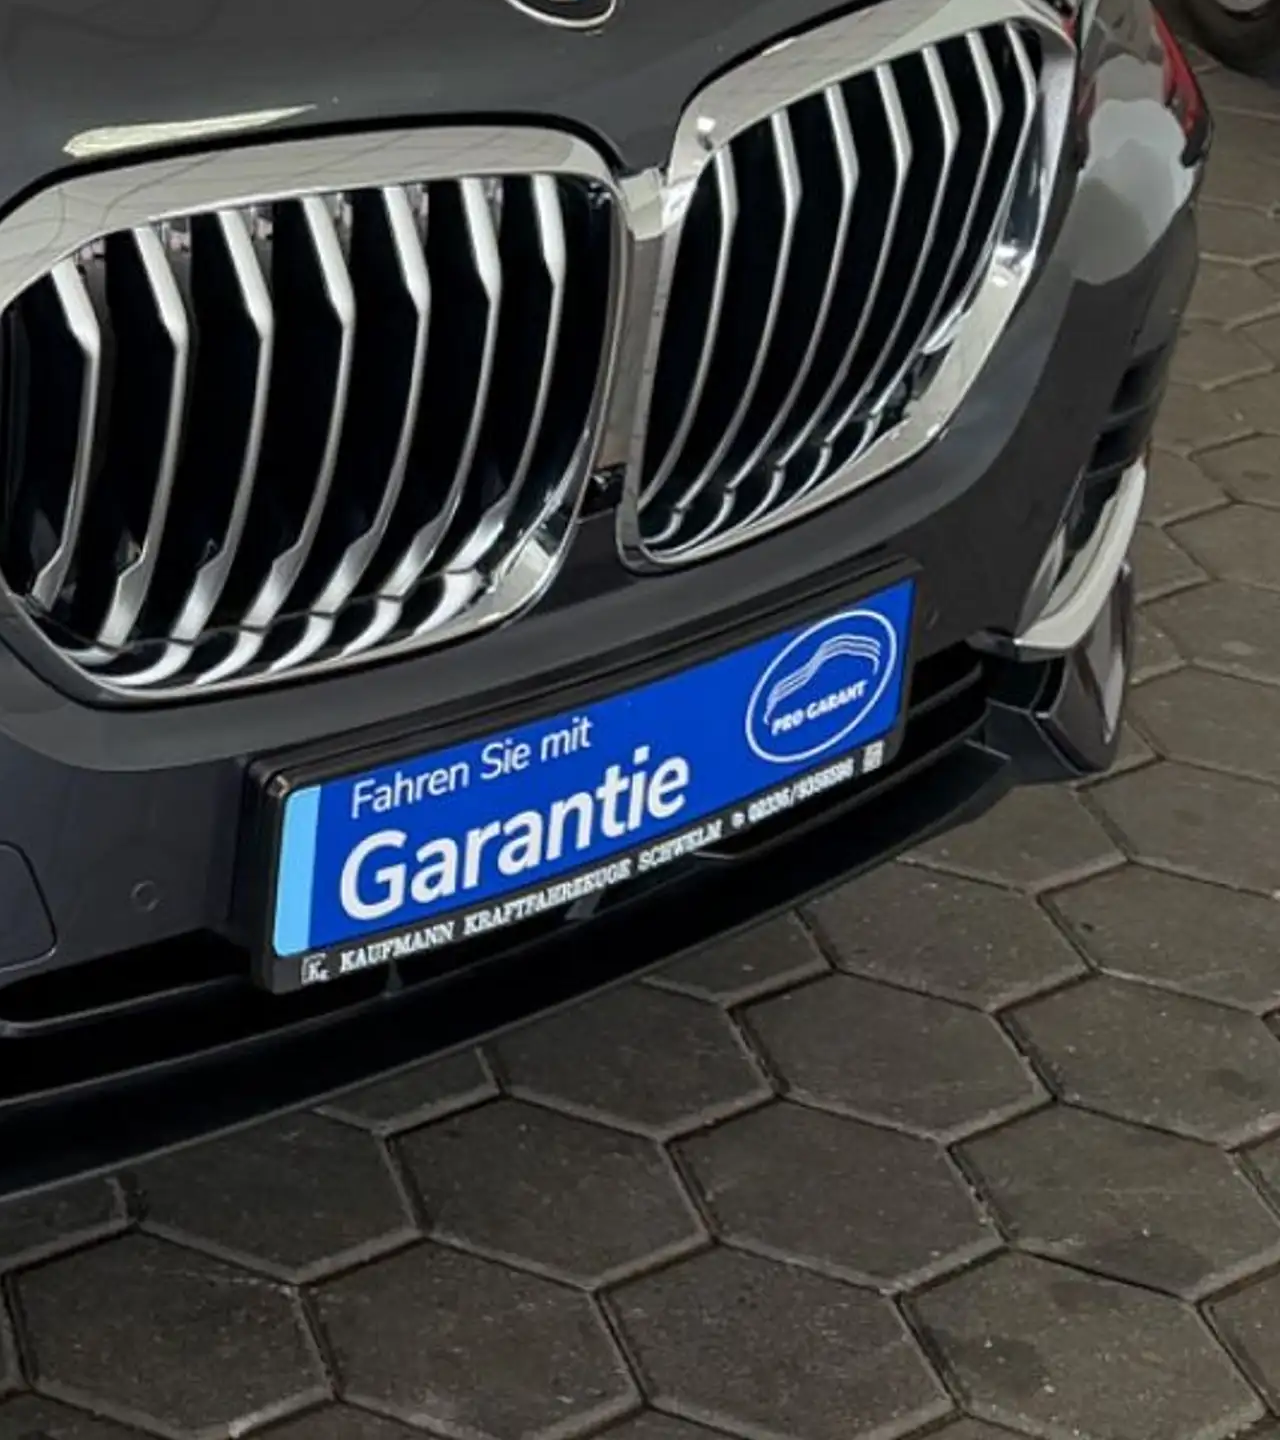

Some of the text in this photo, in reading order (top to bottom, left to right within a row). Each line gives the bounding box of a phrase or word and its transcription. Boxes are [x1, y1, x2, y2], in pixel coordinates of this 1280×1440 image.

[771, 679, 868, 736] PRO GARANT
[351, 716, 593, 819] Fahren Sie mit
[340, 745, 690, 921] Garantie
[340, 920, 455, 973] KAUFMANN
